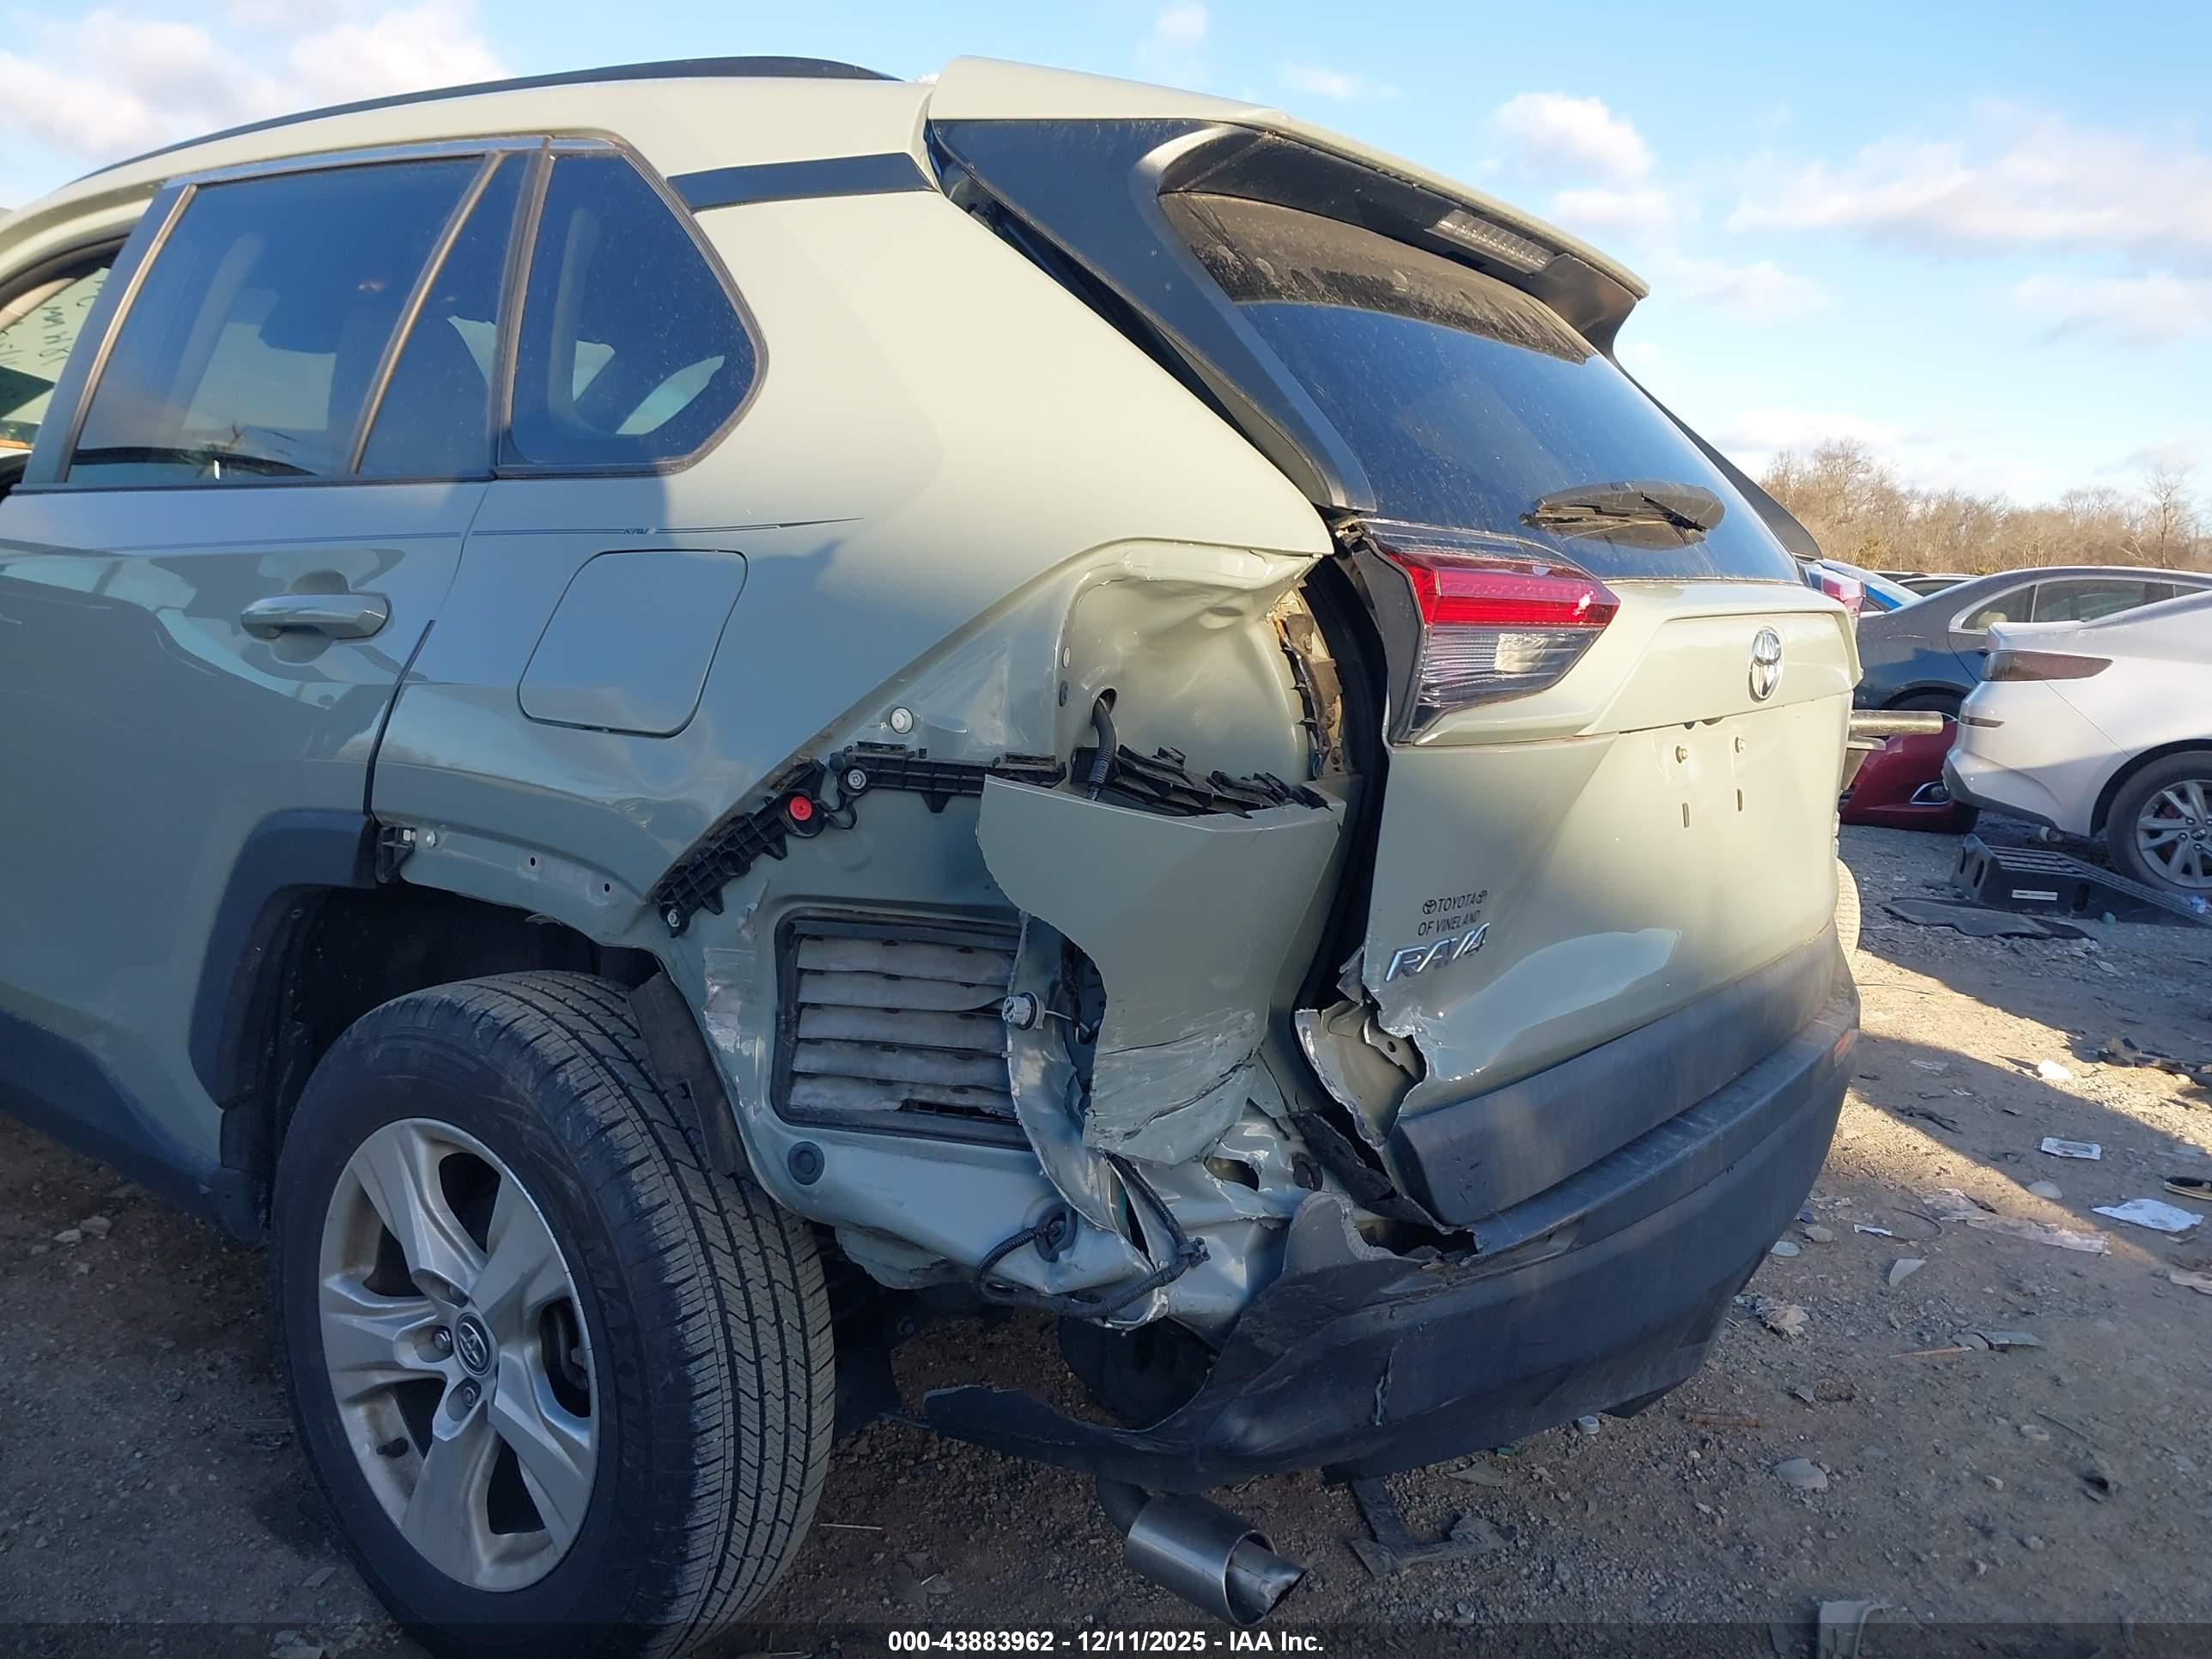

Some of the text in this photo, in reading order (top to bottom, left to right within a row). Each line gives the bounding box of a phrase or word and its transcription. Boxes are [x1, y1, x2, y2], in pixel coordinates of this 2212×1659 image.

[1437, 892, 1477, 912] TOYOTA
[1418, 909, 1481, 936] OF VINELAND
[1384, 922, 1491, 982] RAV4
